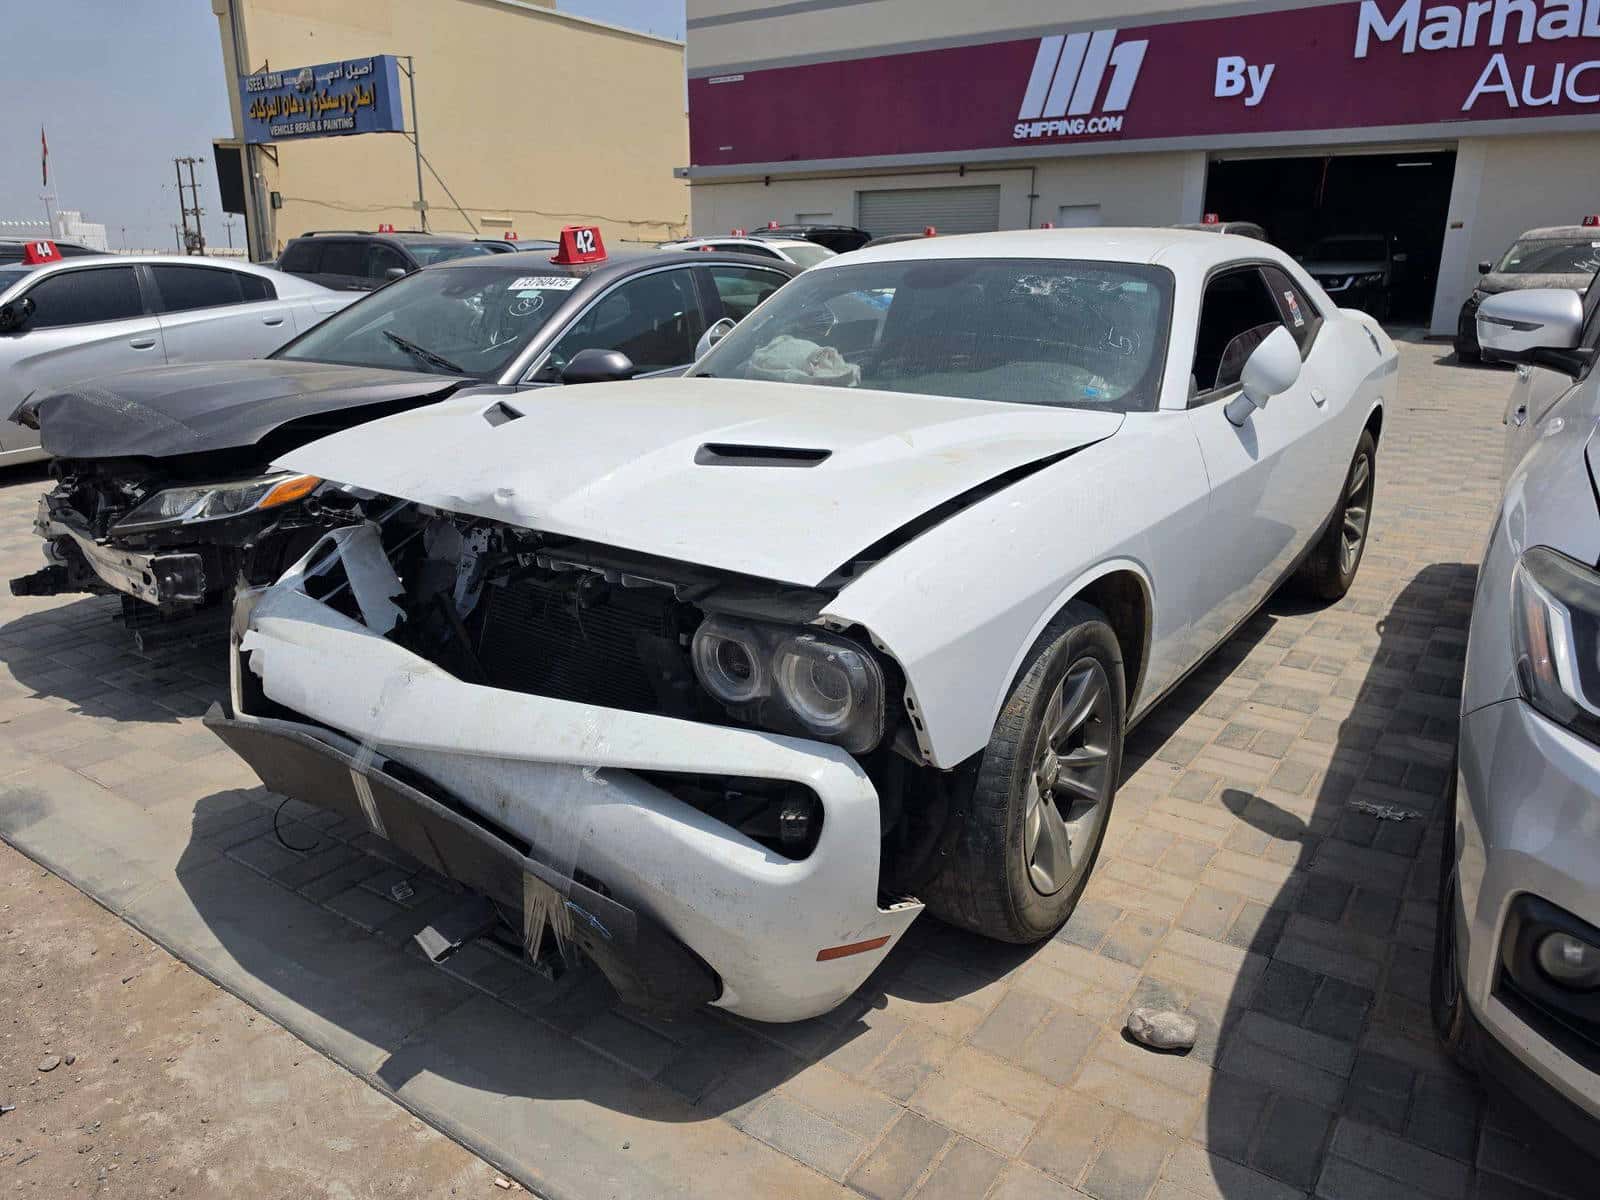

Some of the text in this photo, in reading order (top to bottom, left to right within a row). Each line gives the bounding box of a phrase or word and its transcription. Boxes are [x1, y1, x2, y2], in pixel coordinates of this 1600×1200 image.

[1214, 56, 1275, 106] By
[1461, 53, 1600, 111] Auc
[270, 117, 354, 136] VEHICLE REPAIR & PAINTING
[1013, 116, 1123, 139] SHIPPING.COM
[36, 241, 53, 257] 44
[577, 230, 596, 253] 42
